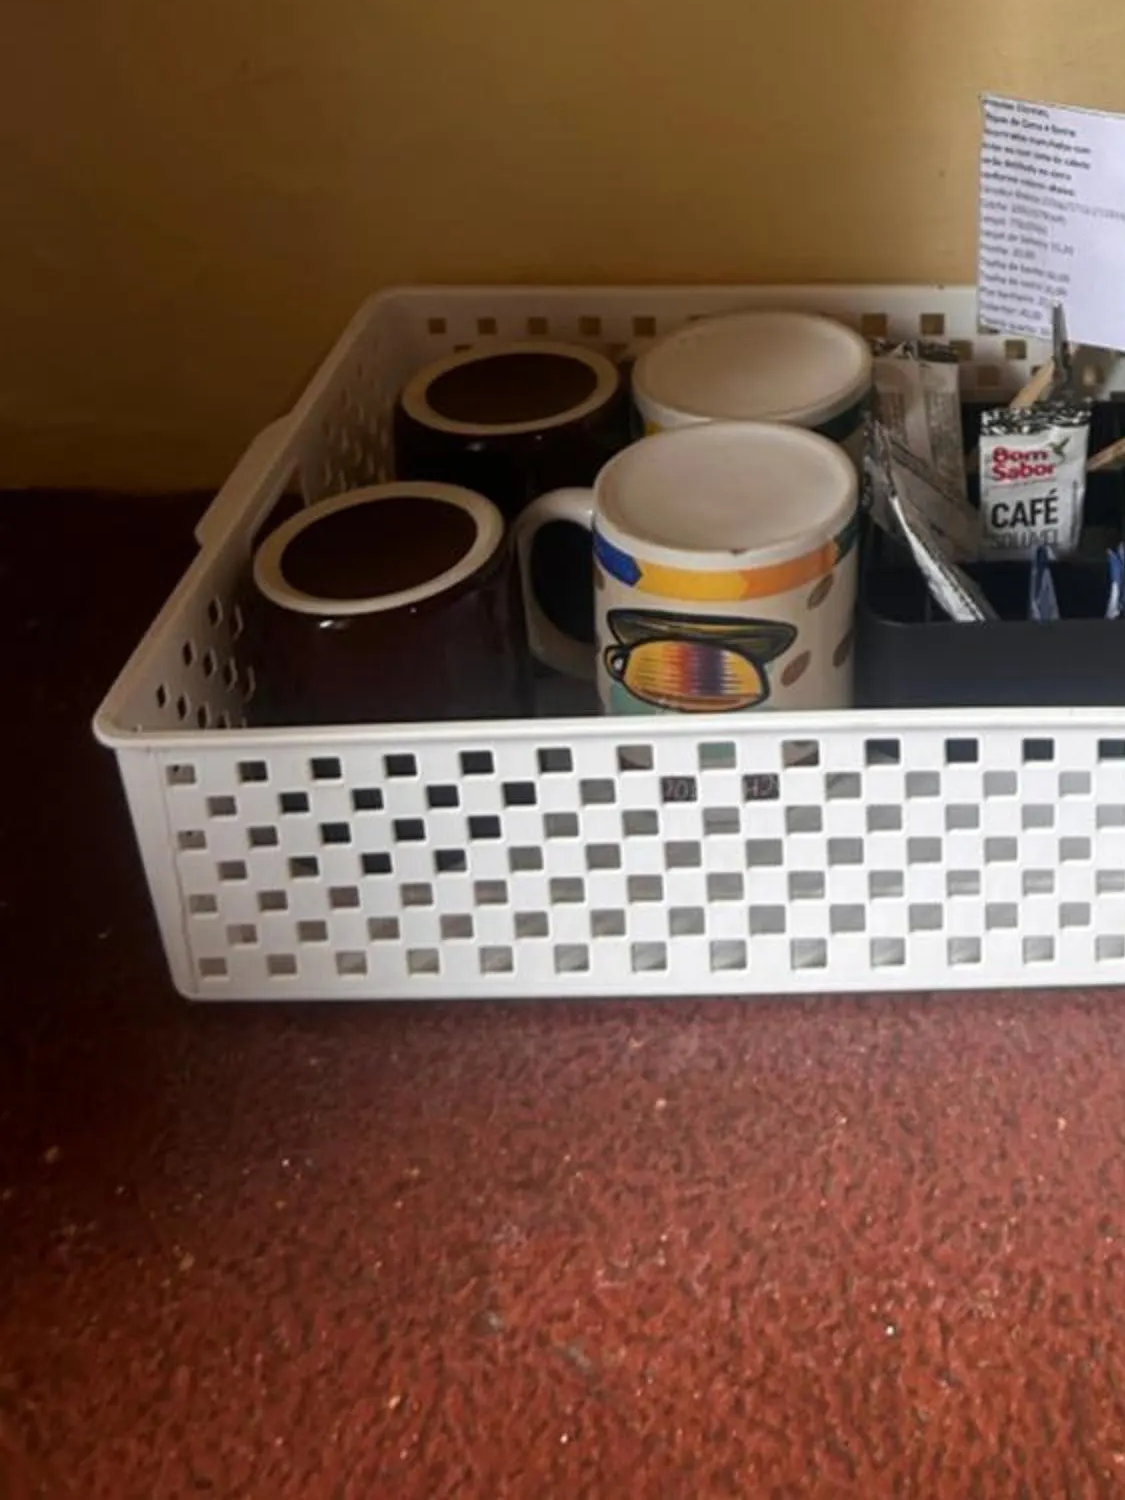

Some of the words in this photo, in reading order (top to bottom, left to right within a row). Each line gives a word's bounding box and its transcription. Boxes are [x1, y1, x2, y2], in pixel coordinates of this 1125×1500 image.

[992, 446, 1049, 463] Bom
[991, 462, 1056, 482] Sabor
[991, 488, 1059, 529] CAFÉ
